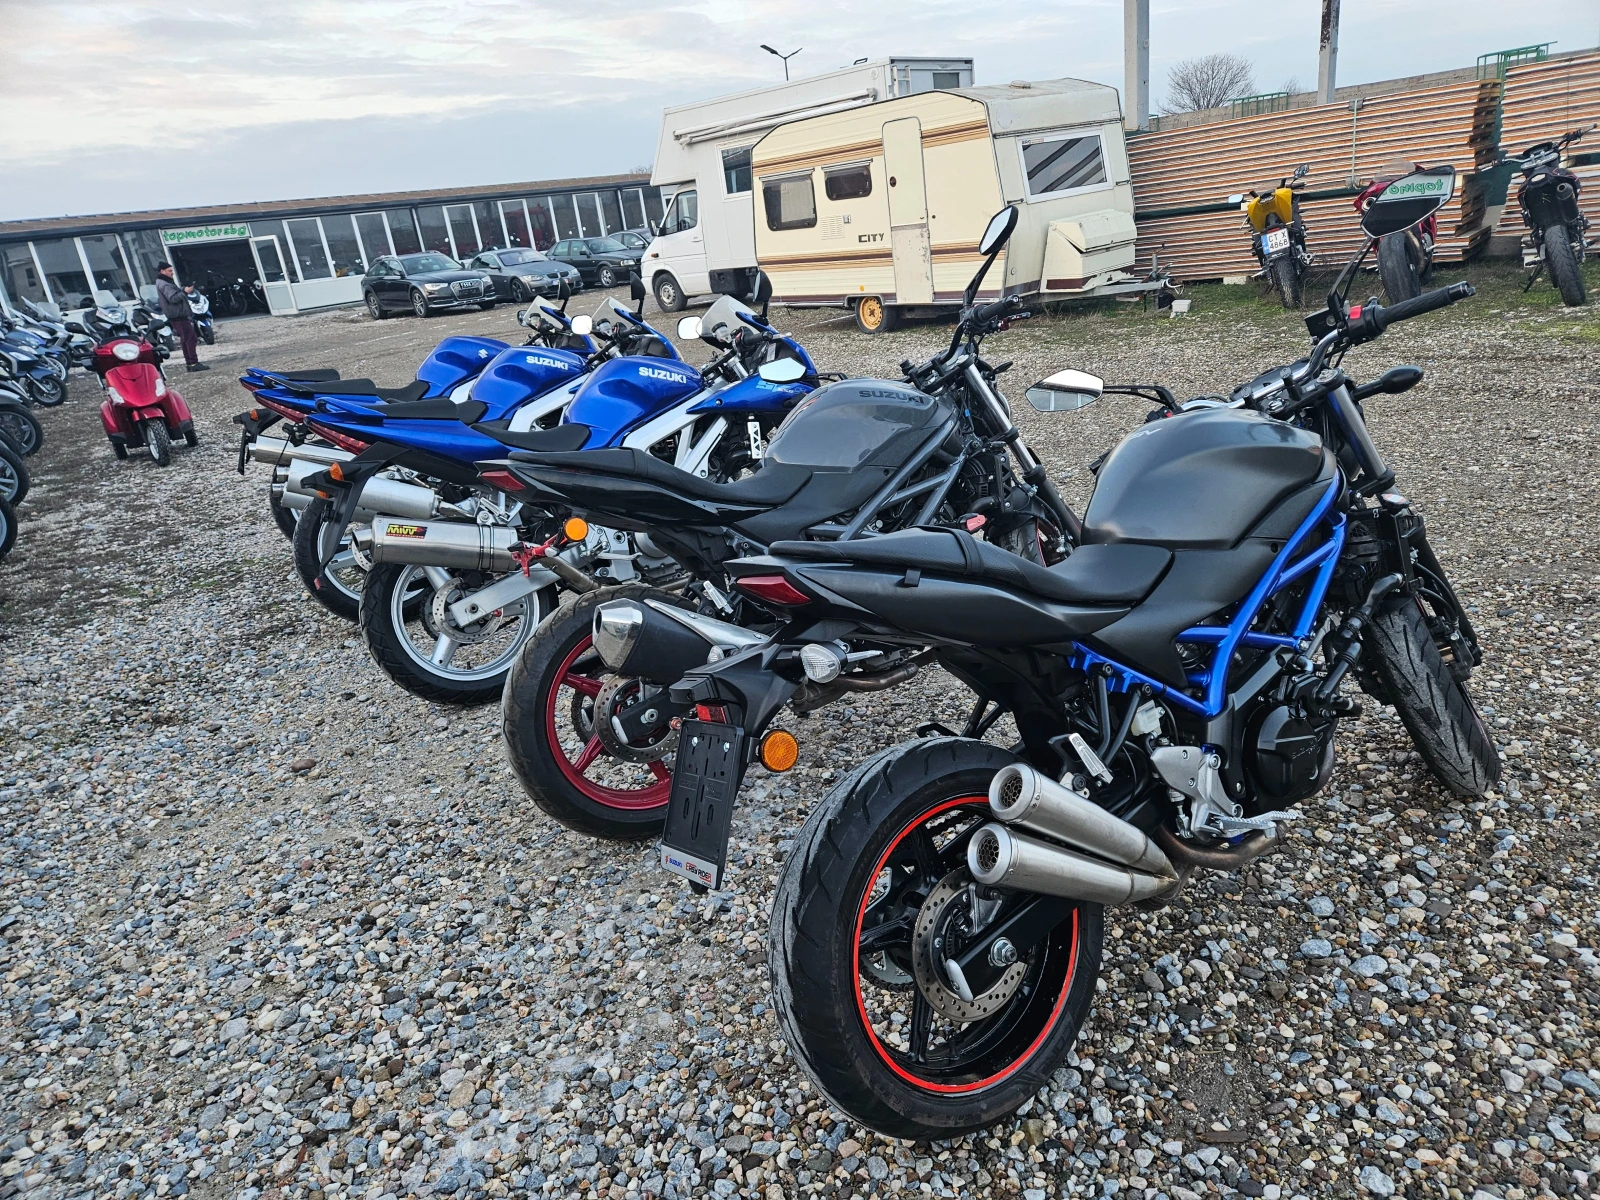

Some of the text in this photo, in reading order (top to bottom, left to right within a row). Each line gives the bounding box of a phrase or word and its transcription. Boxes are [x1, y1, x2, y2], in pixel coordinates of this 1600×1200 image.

[858, 233, 885, 243] CITY
[1268, 233, 1279, 243] CT
[1270, 238, 1289, 250] 4868
[525, 355, 569, 371] SUZUKI
[638, 366, 687, 384] SUZUKI
[859, 390, 925, 404] SUZUKI
[669, 857, 683, 869] SUZUKI
